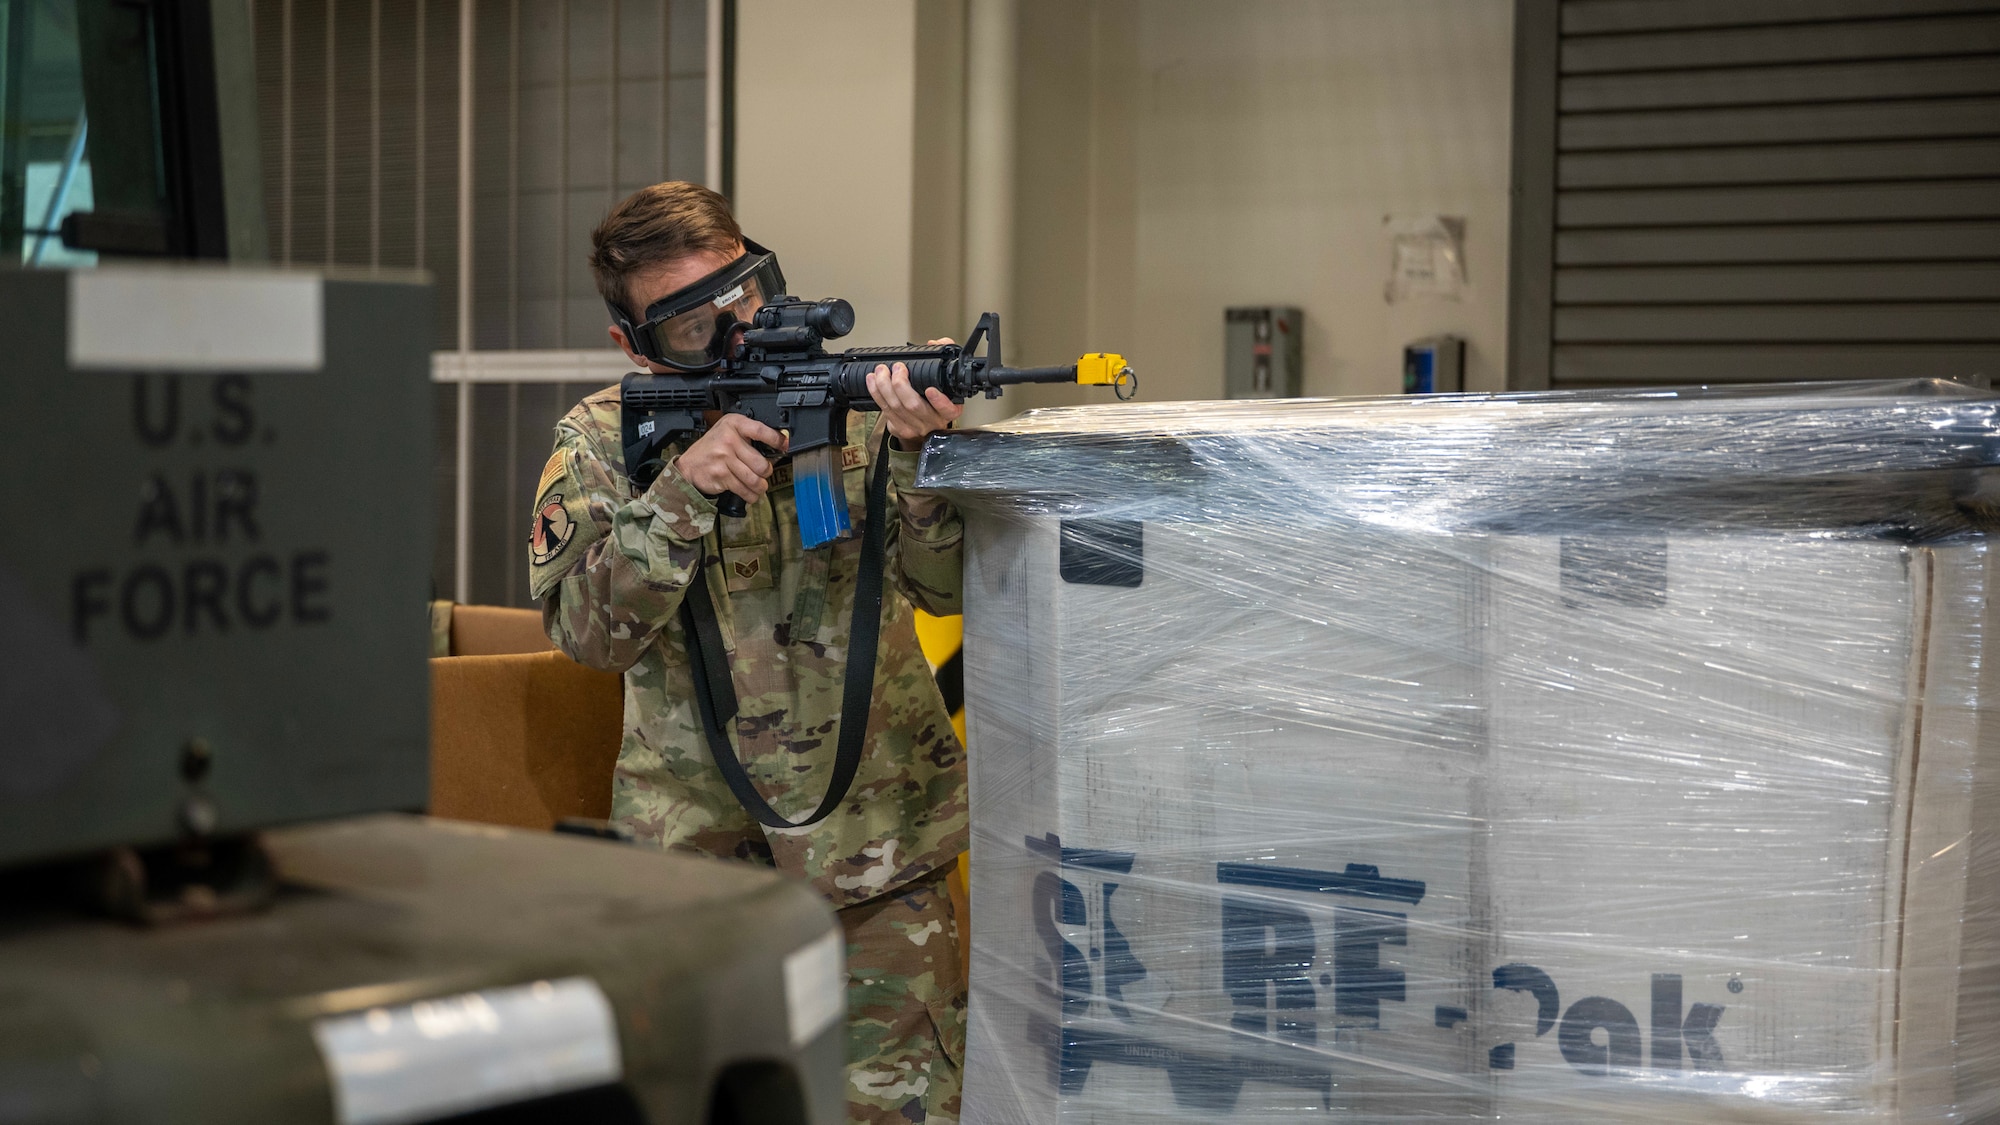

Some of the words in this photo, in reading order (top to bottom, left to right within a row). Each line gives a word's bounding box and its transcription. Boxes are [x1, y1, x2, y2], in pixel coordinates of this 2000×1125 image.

[133, 370, 277, 448] U.S.
[133, 468, 263, 546] AIR
[70, 549, 333, 647] FORCE
[1124, 1045, 1185, 1063] UNIVERSAL
